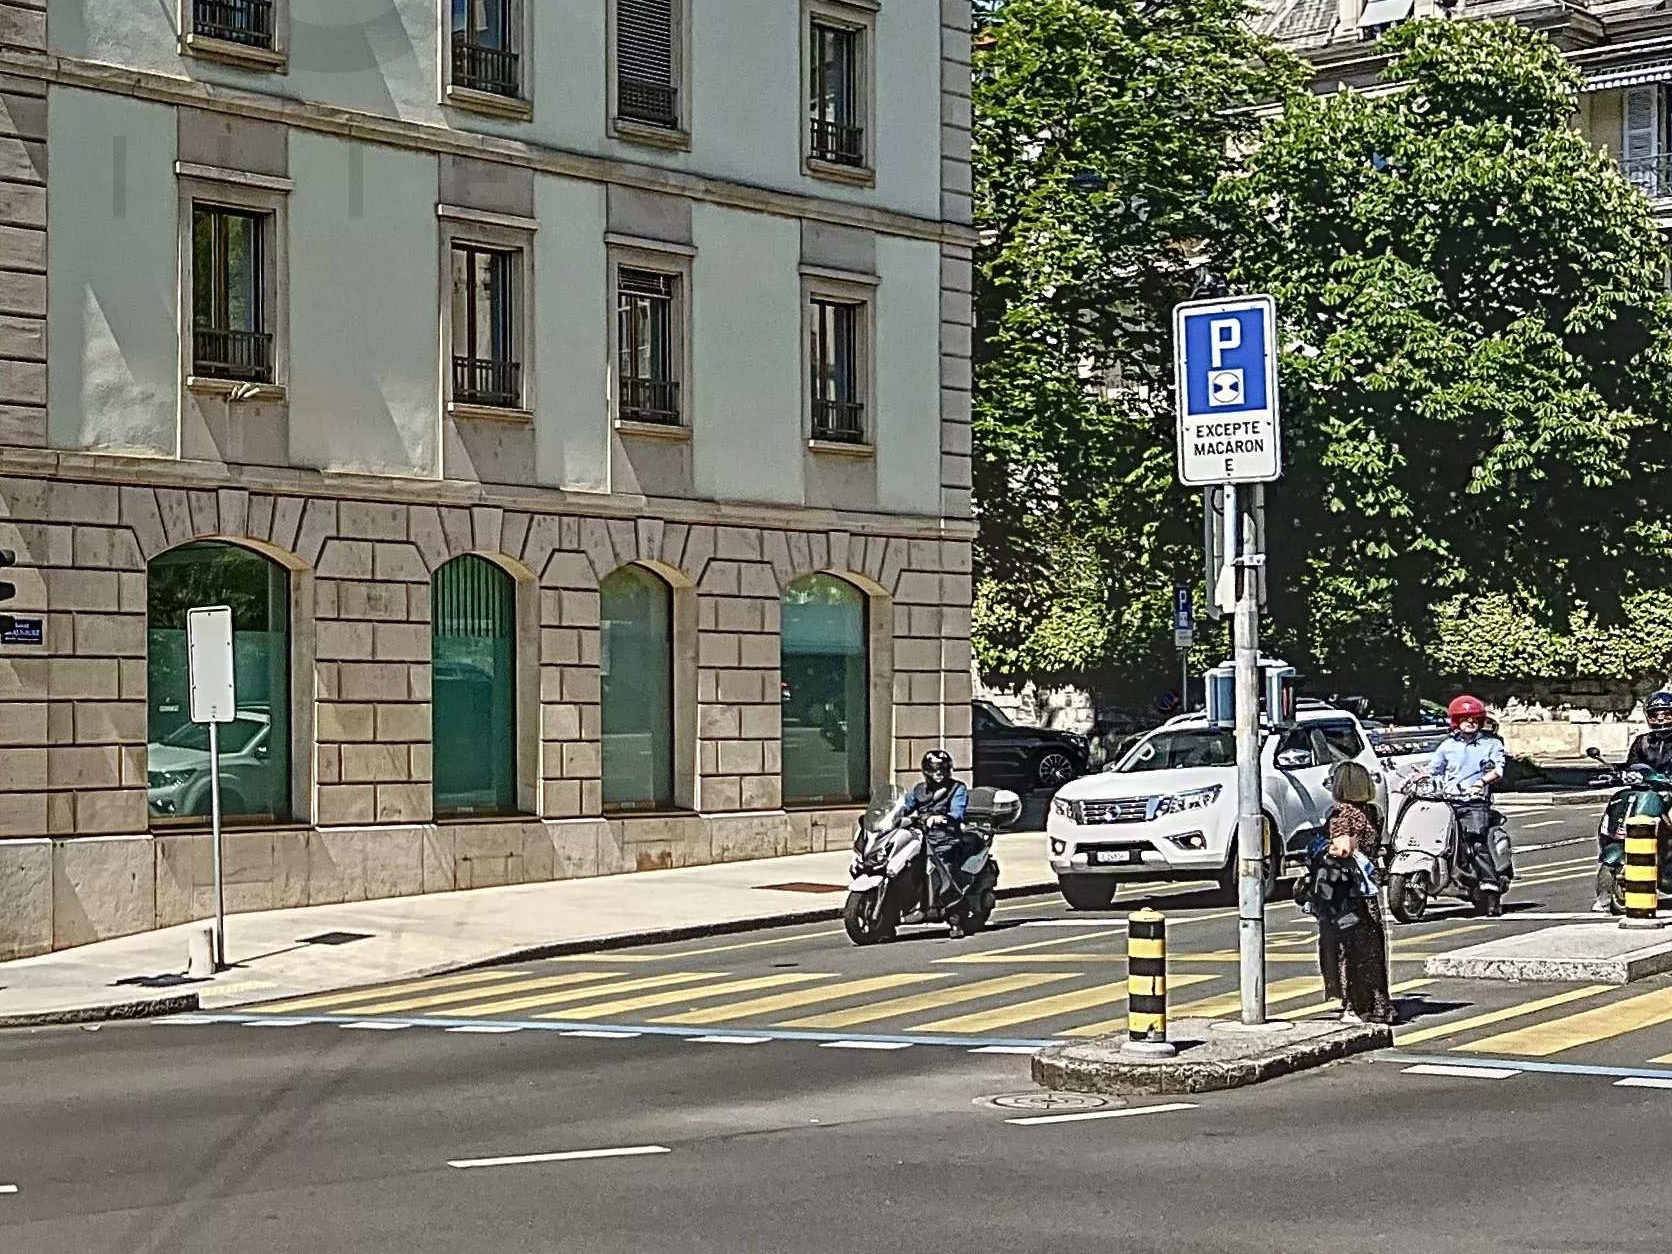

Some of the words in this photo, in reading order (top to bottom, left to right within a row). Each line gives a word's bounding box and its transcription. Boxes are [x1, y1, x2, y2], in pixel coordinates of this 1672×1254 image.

[1209, 318, 1241, 368] P
[1196, 420, 1261, 439] EXCEPTE
[1194, 438, 1264, 457] MACARON
[1224, 458, 1234, 472] E
[1179, 589, 1187, 611] P
